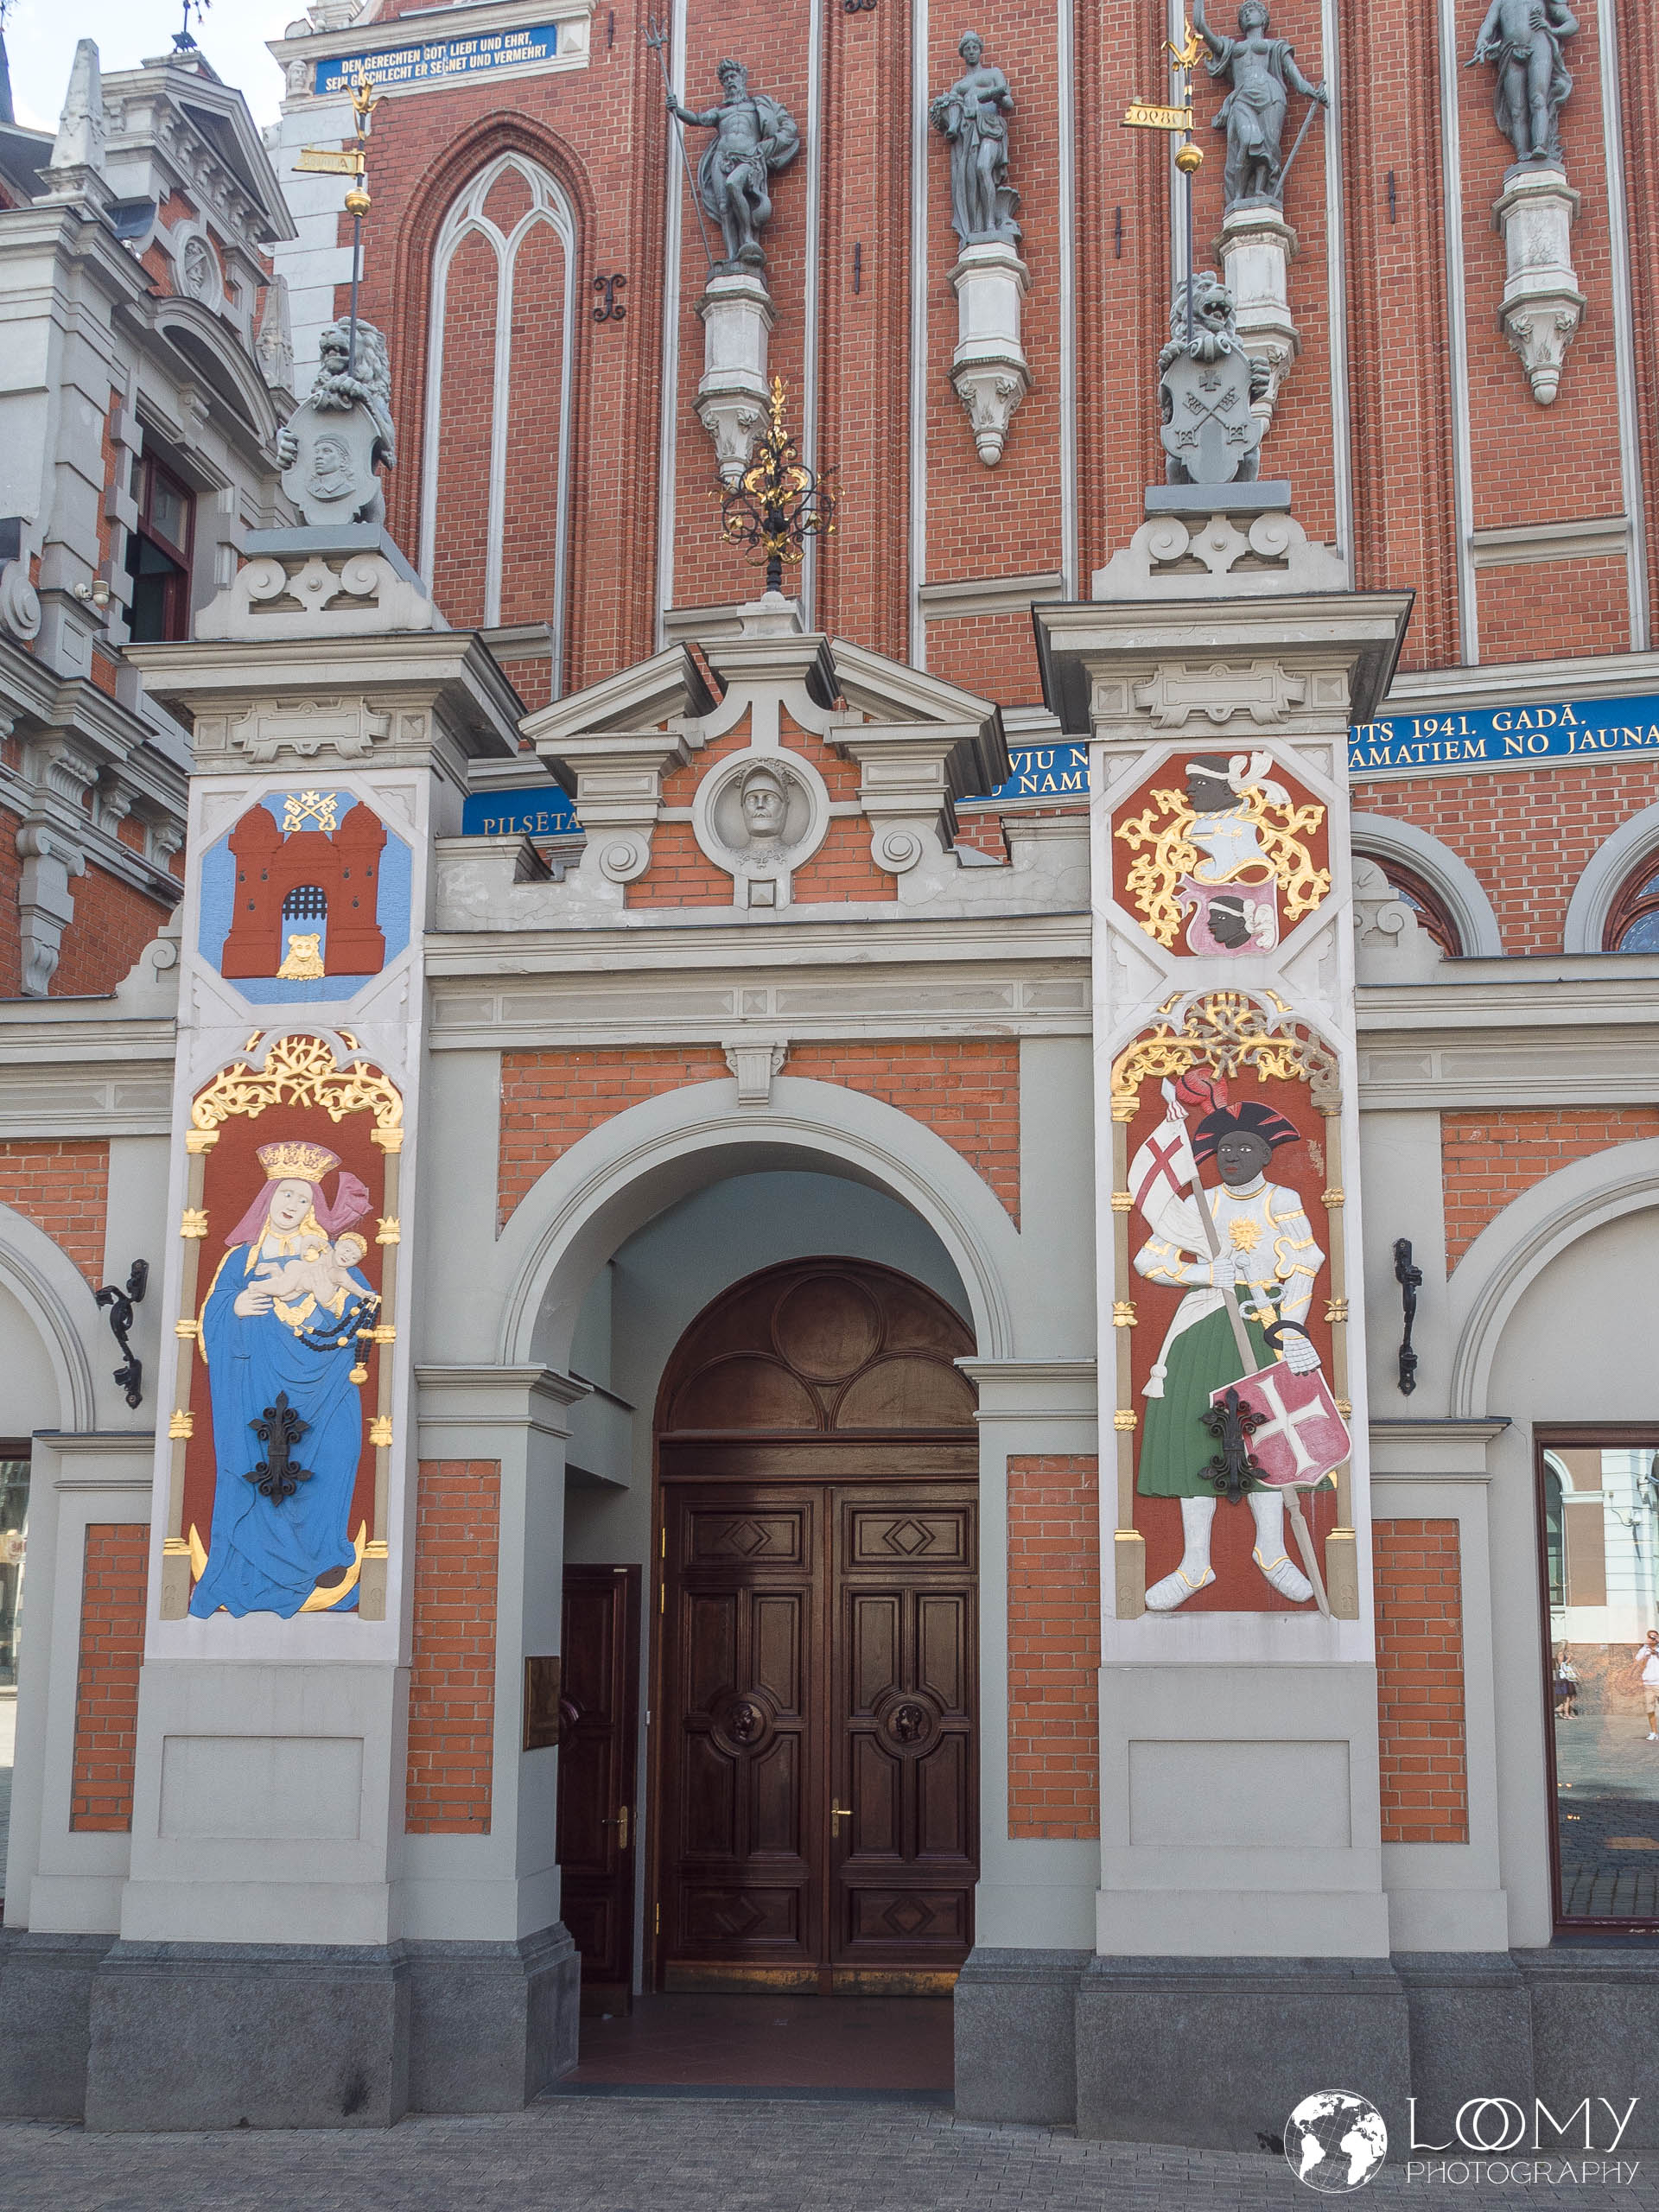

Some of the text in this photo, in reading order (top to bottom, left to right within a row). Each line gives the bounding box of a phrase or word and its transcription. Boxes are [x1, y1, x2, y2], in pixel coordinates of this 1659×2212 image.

[341, 59, 362, 73] DEN
[364, 50, 421, 70] GERECHTEN
[450, 41, 477, 56] LIEBT
[480, 37, 501, 52] UND
[505, 32, 532, 48] EHRT,
[415, 63, 428, 77] ER
[469, 54, 492, 68] UND
[493, 44, 547, 65] VERMEHRT
[1411, 716, 1477, 738] 1941.
[1491, 704, 1586, 731] GADĀ.
[1502, 734, 1549, 756] NO
